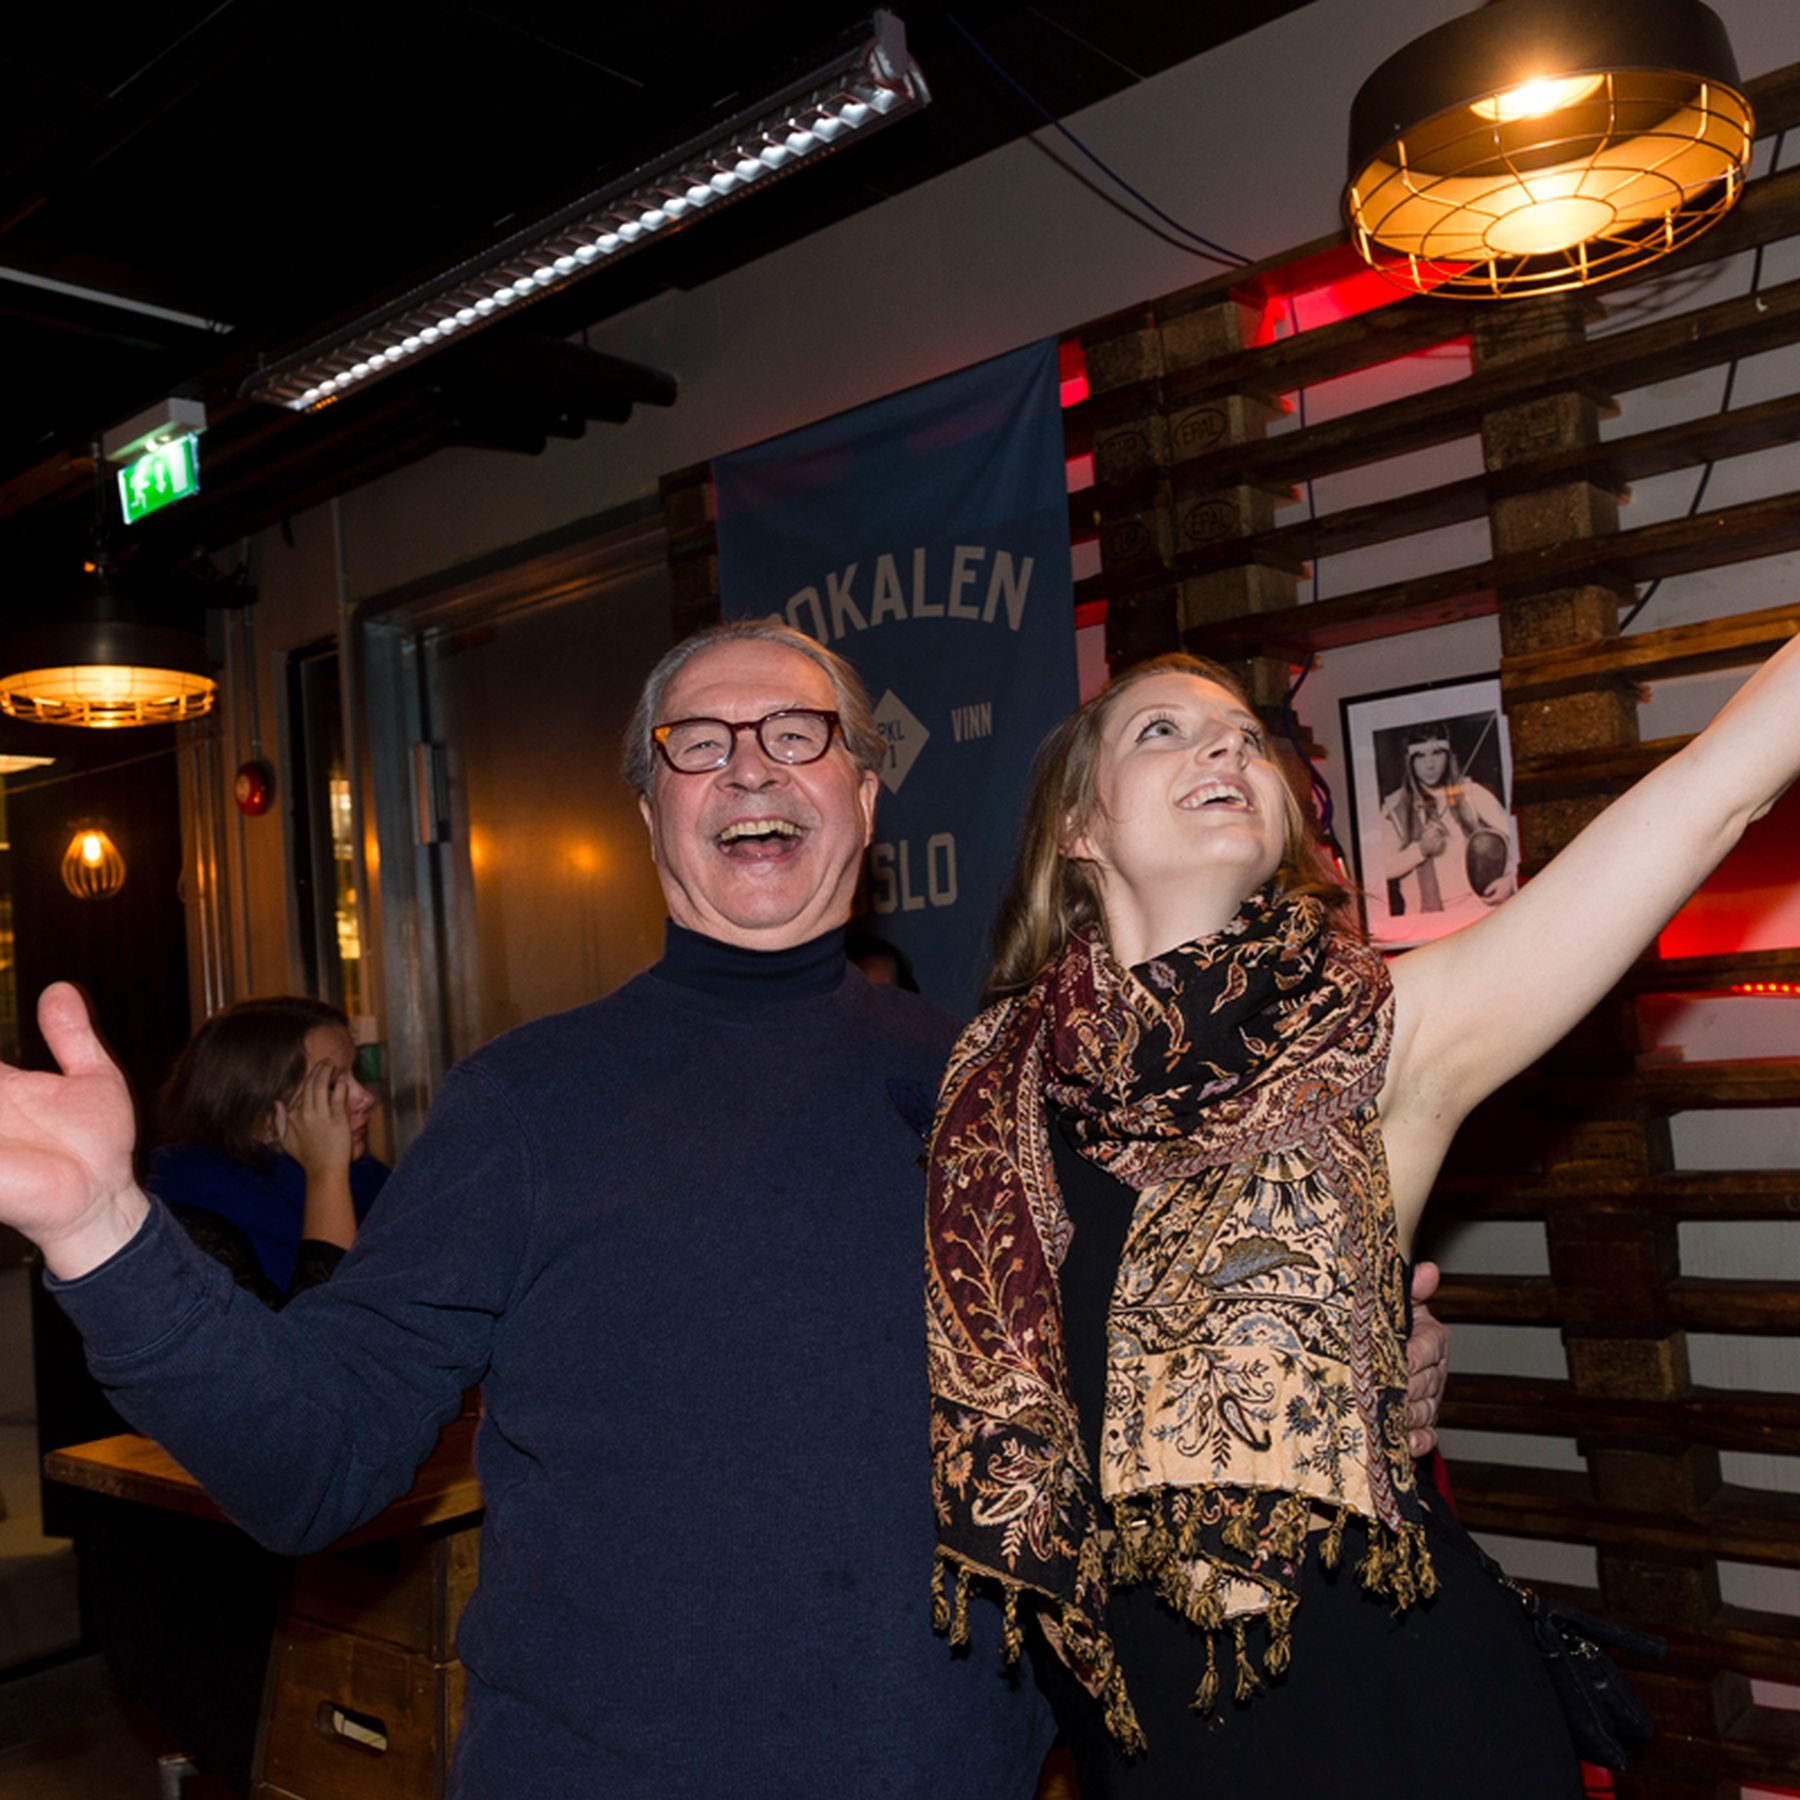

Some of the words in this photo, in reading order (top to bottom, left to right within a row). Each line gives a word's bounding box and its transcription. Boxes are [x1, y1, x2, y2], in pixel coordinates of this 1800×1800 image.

[767, 546, 1034, 646] OKALEN
[951, 701, 992, 743] VINN
[870, 832, 958, 914] SLO
